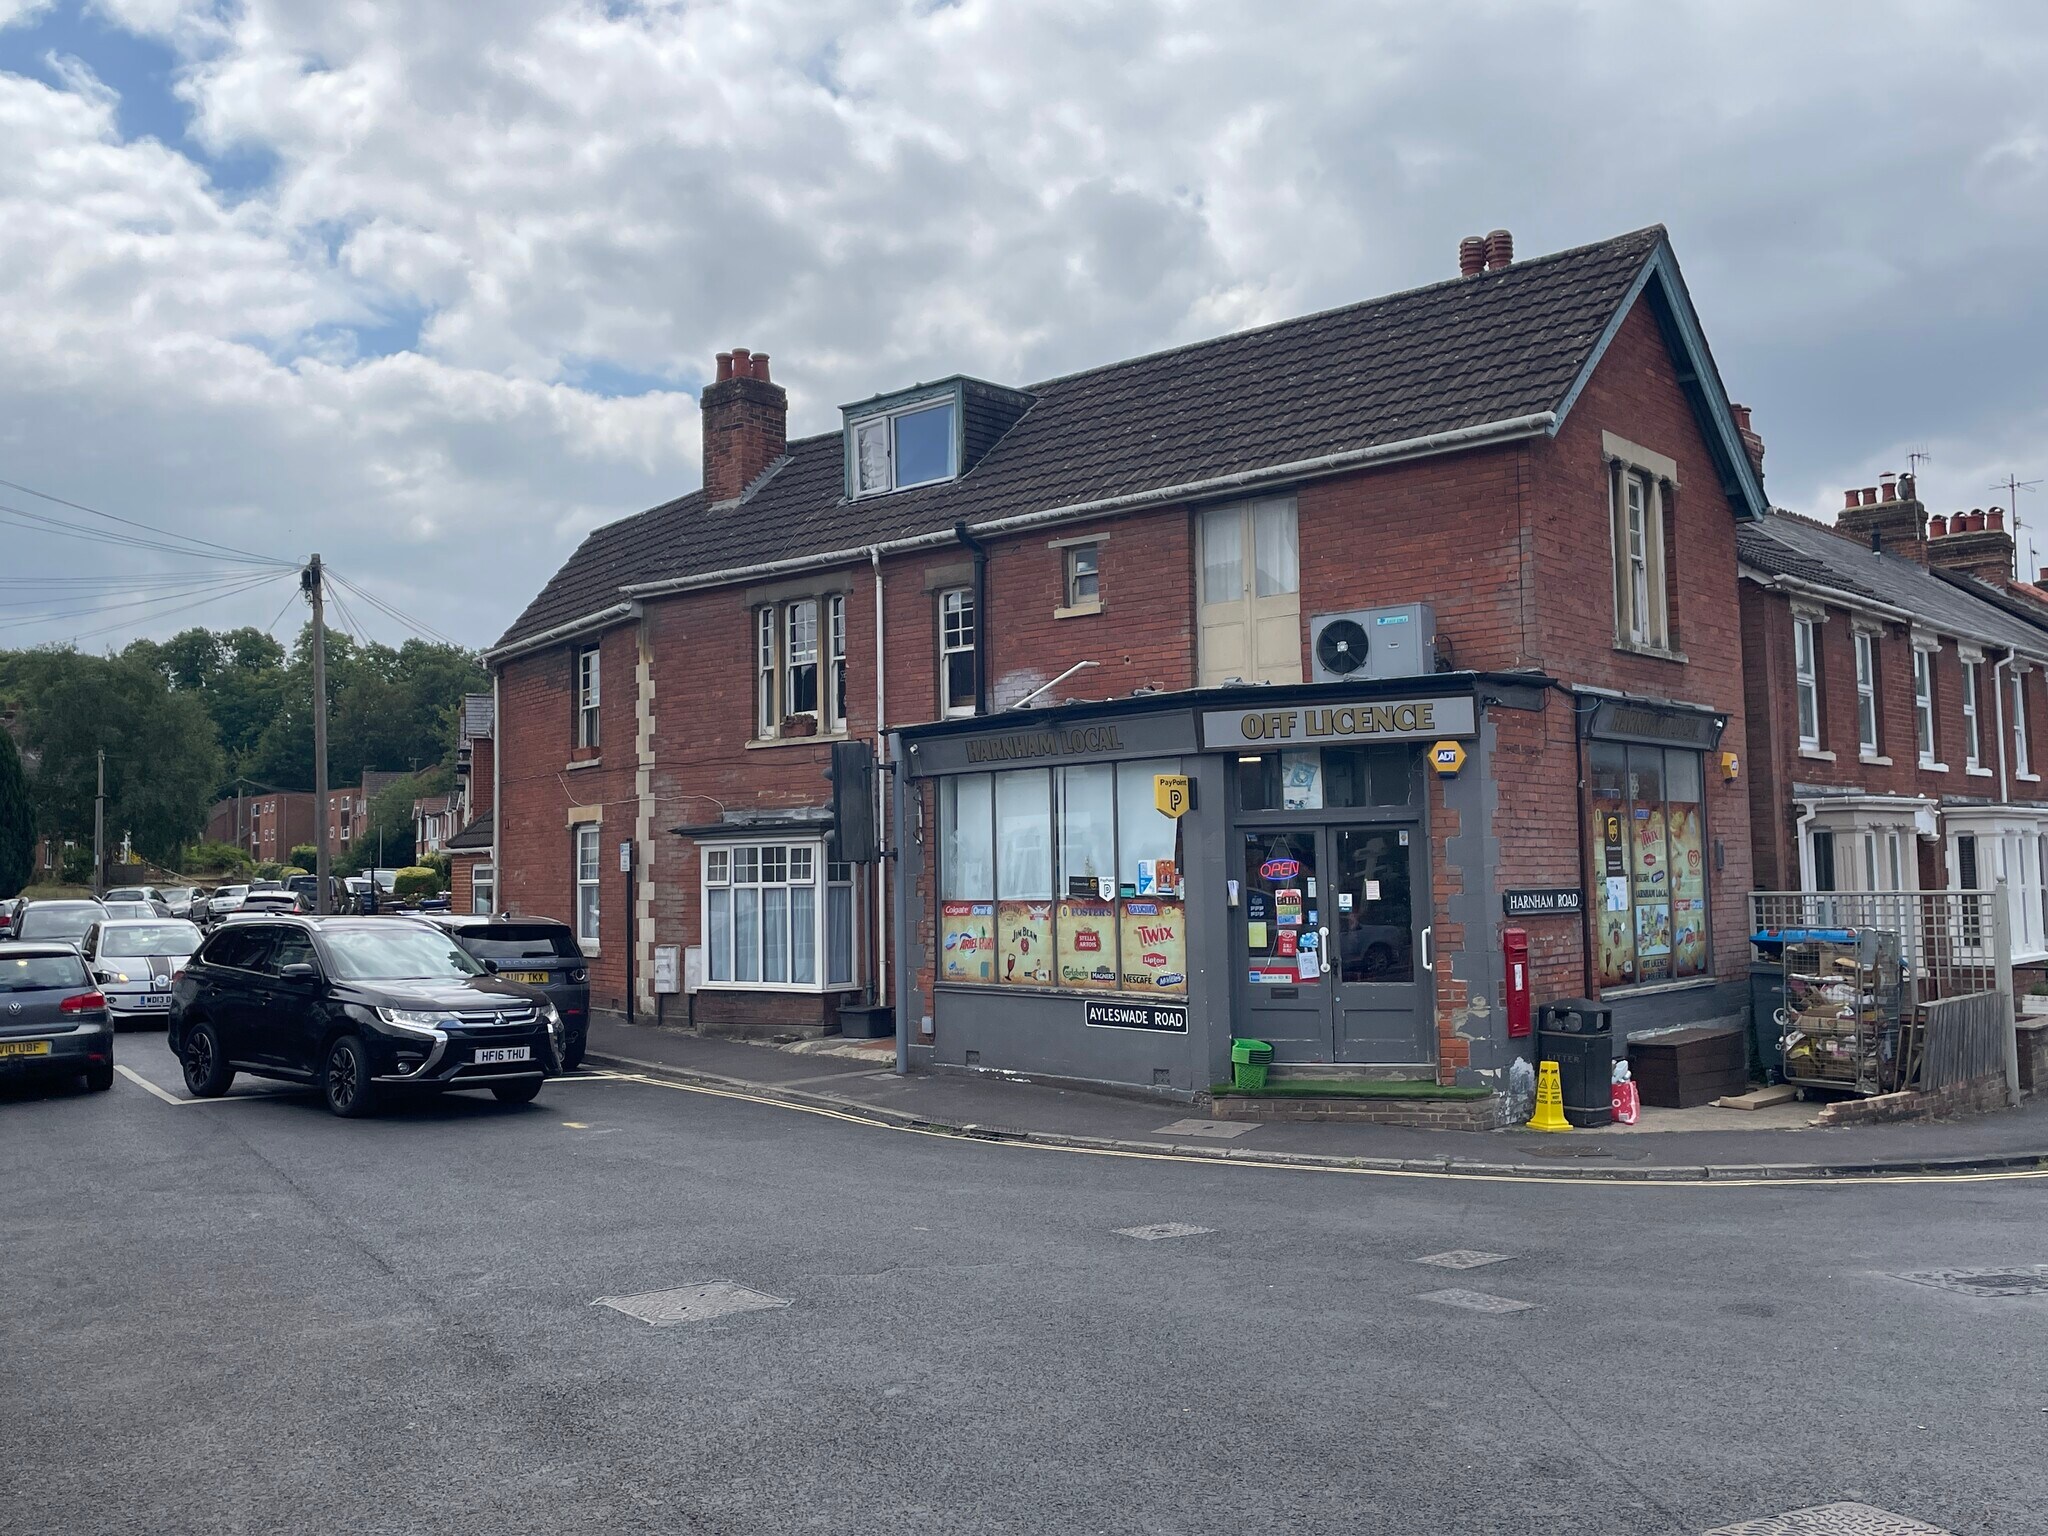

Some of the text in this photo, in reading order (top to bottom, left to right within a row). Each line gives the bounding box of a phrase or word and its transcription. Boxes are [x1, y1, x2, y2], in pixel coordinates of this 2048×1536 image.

[1241, 703, 1435, 740] OFF LICENCE
[965, 726, 1124, 763] HARNHAM LOCAL
[1438, 751, 1456, 761] ADT
[1160, 779, 1187, 787] PayPoint
[1260, 861, 1300, 877] OPEN
[1510, 893, 1578, 909] HARNHAM ROAD
[945, 905, 968, 915] Colgate
[1071, 907, 1112, 917] FOSTER'S
[1012, 926, 1037, 943] JIM BEAM
[960, 938, 977, 950] ARIEL
[1144, 956, 1165, 965] Lipton
[528, 973, 543, 981] TKX
[1063, 966, 1088, 980] Carlsberg
[1092, 972, 1114, 980] MAGNERS
[1123, 973, 1153, 984] NESCAFÉ
[1089, 1007, 1183, 1027] AYLESWADE ROAD
[18, 1043, 40, 1052] UBF
[482, 1049, 524, 1061] HF16 THU
[1547, 1054, 1580, 1064] LITTER
